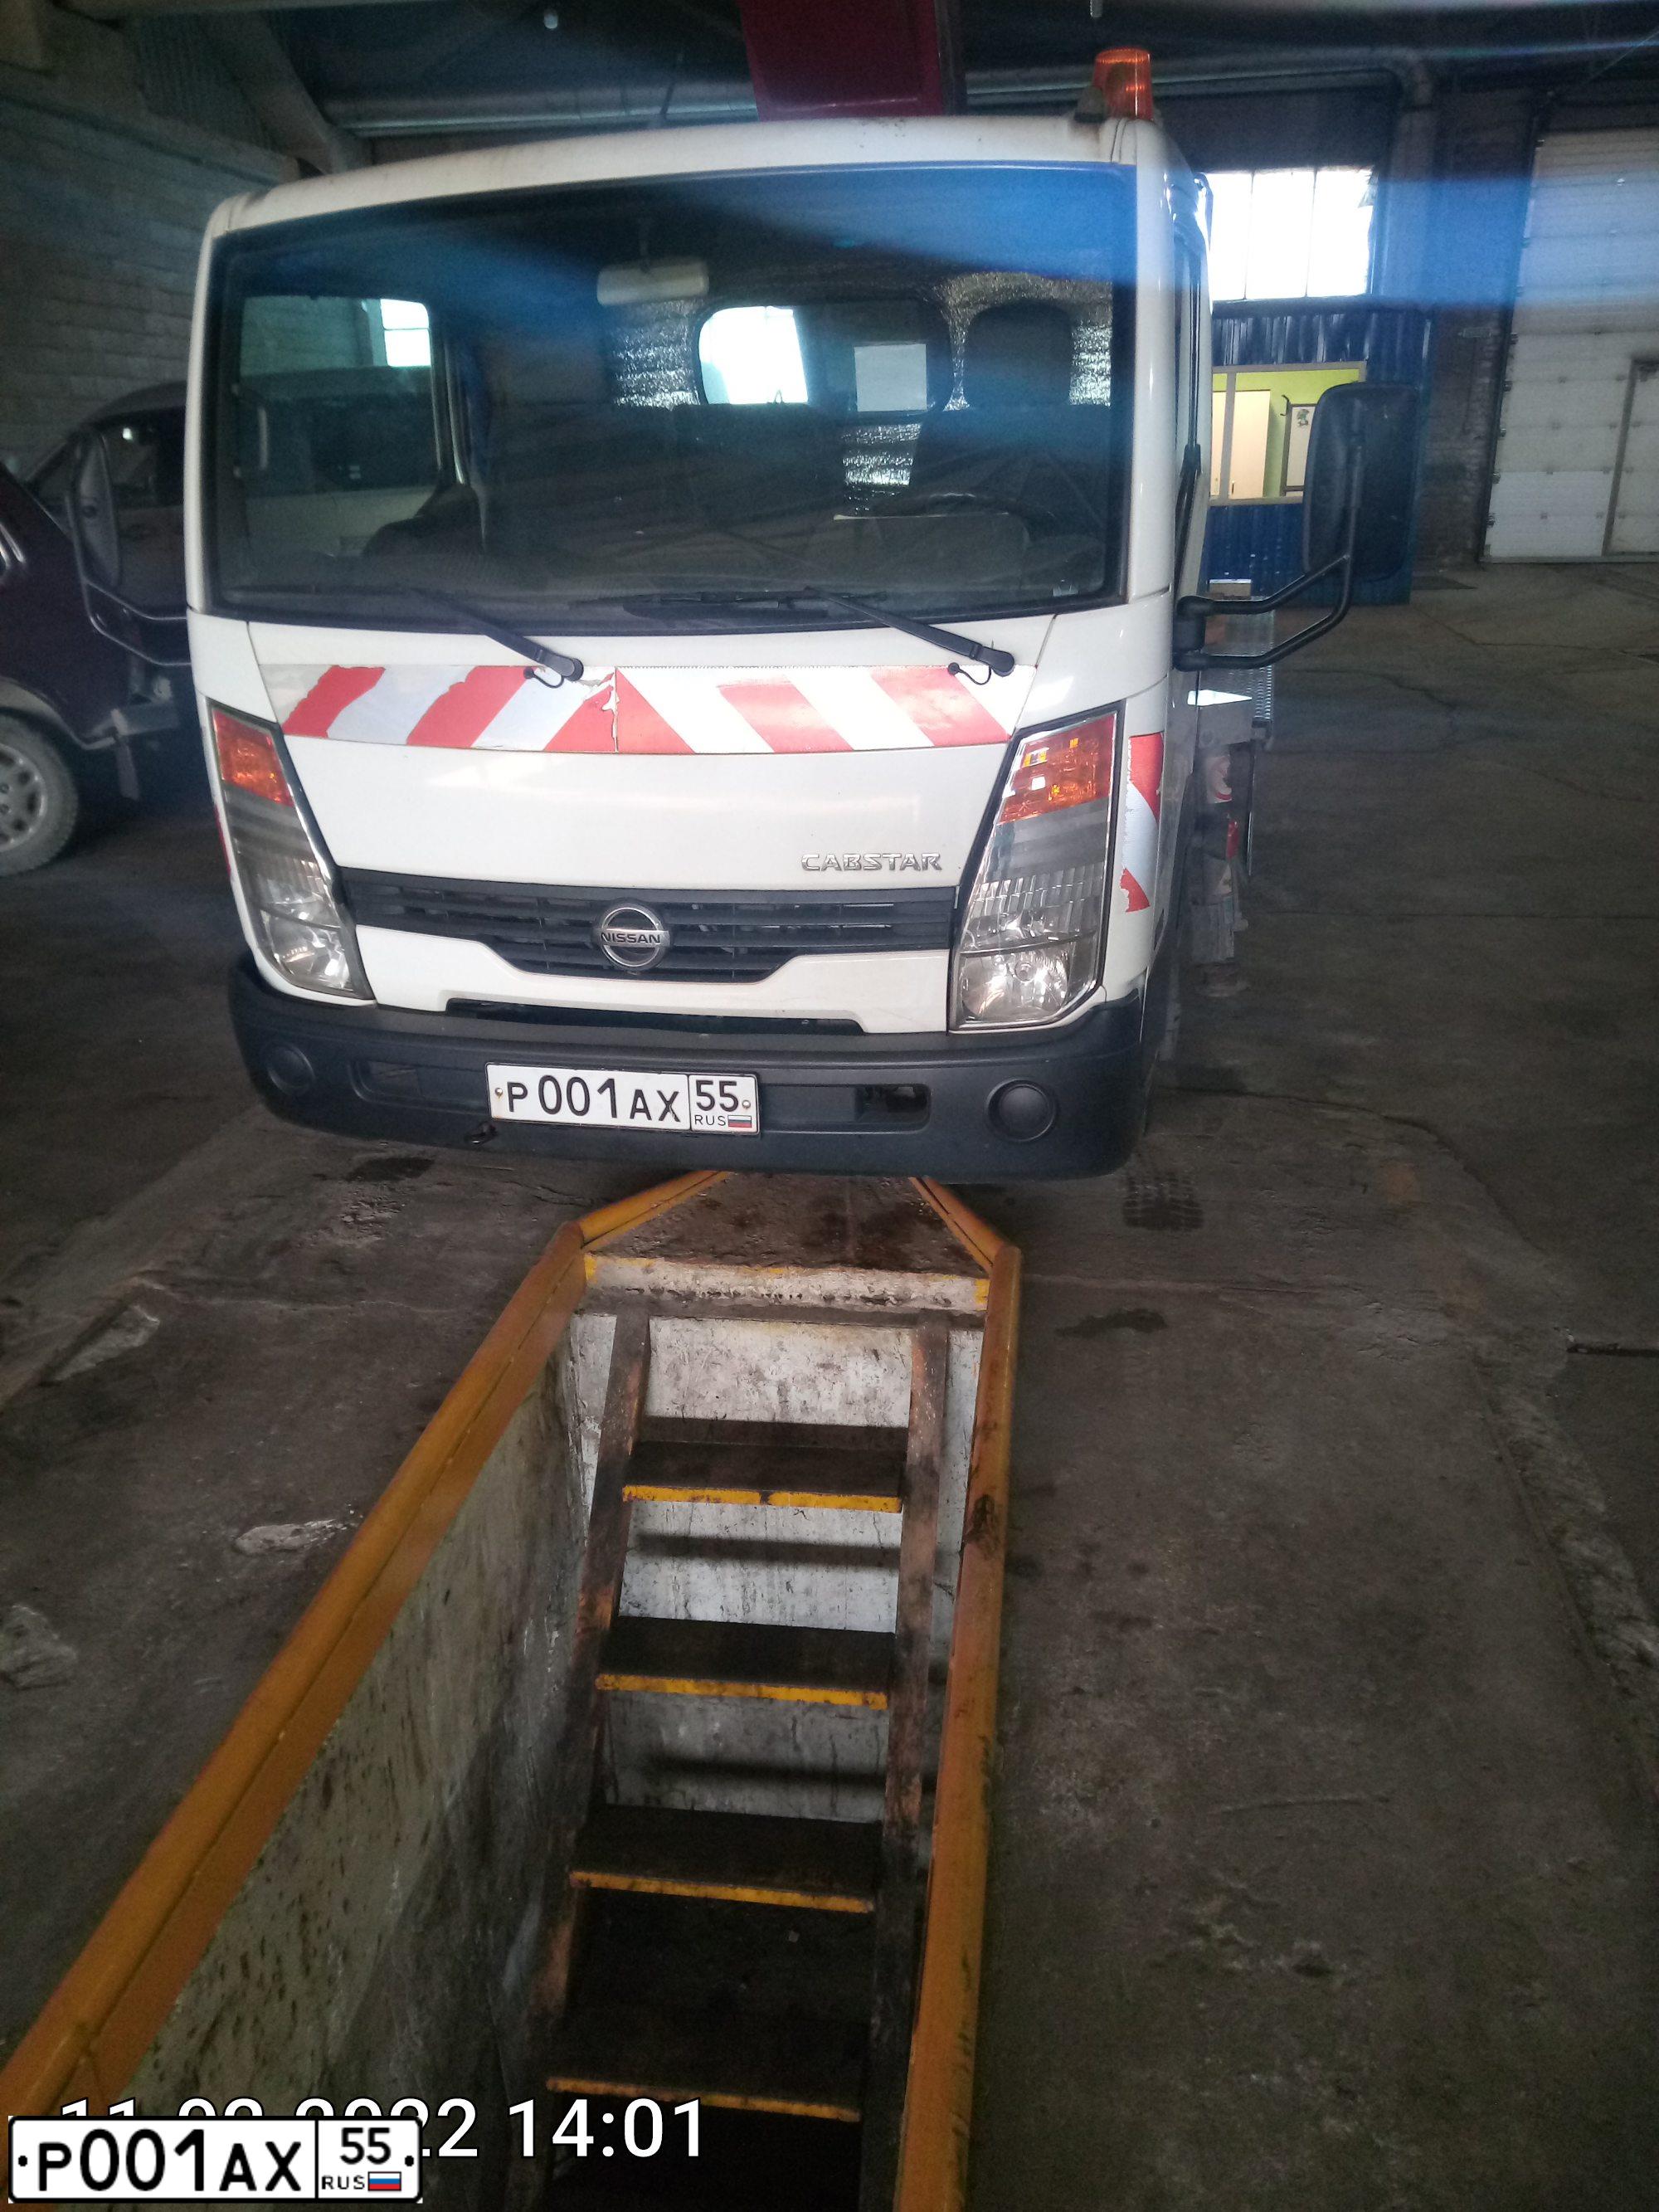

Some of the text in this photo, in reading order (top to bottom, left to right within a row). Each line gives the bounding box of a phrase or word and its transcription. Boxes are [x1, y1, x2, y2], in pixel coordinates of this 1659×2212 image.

[801, 853, 942, 871] CABSTAR
[600, 931, 661, 944] NISSAN
[696, 1080, 739, 1112] 55
[694, 1113, 727, 1126] RUS
